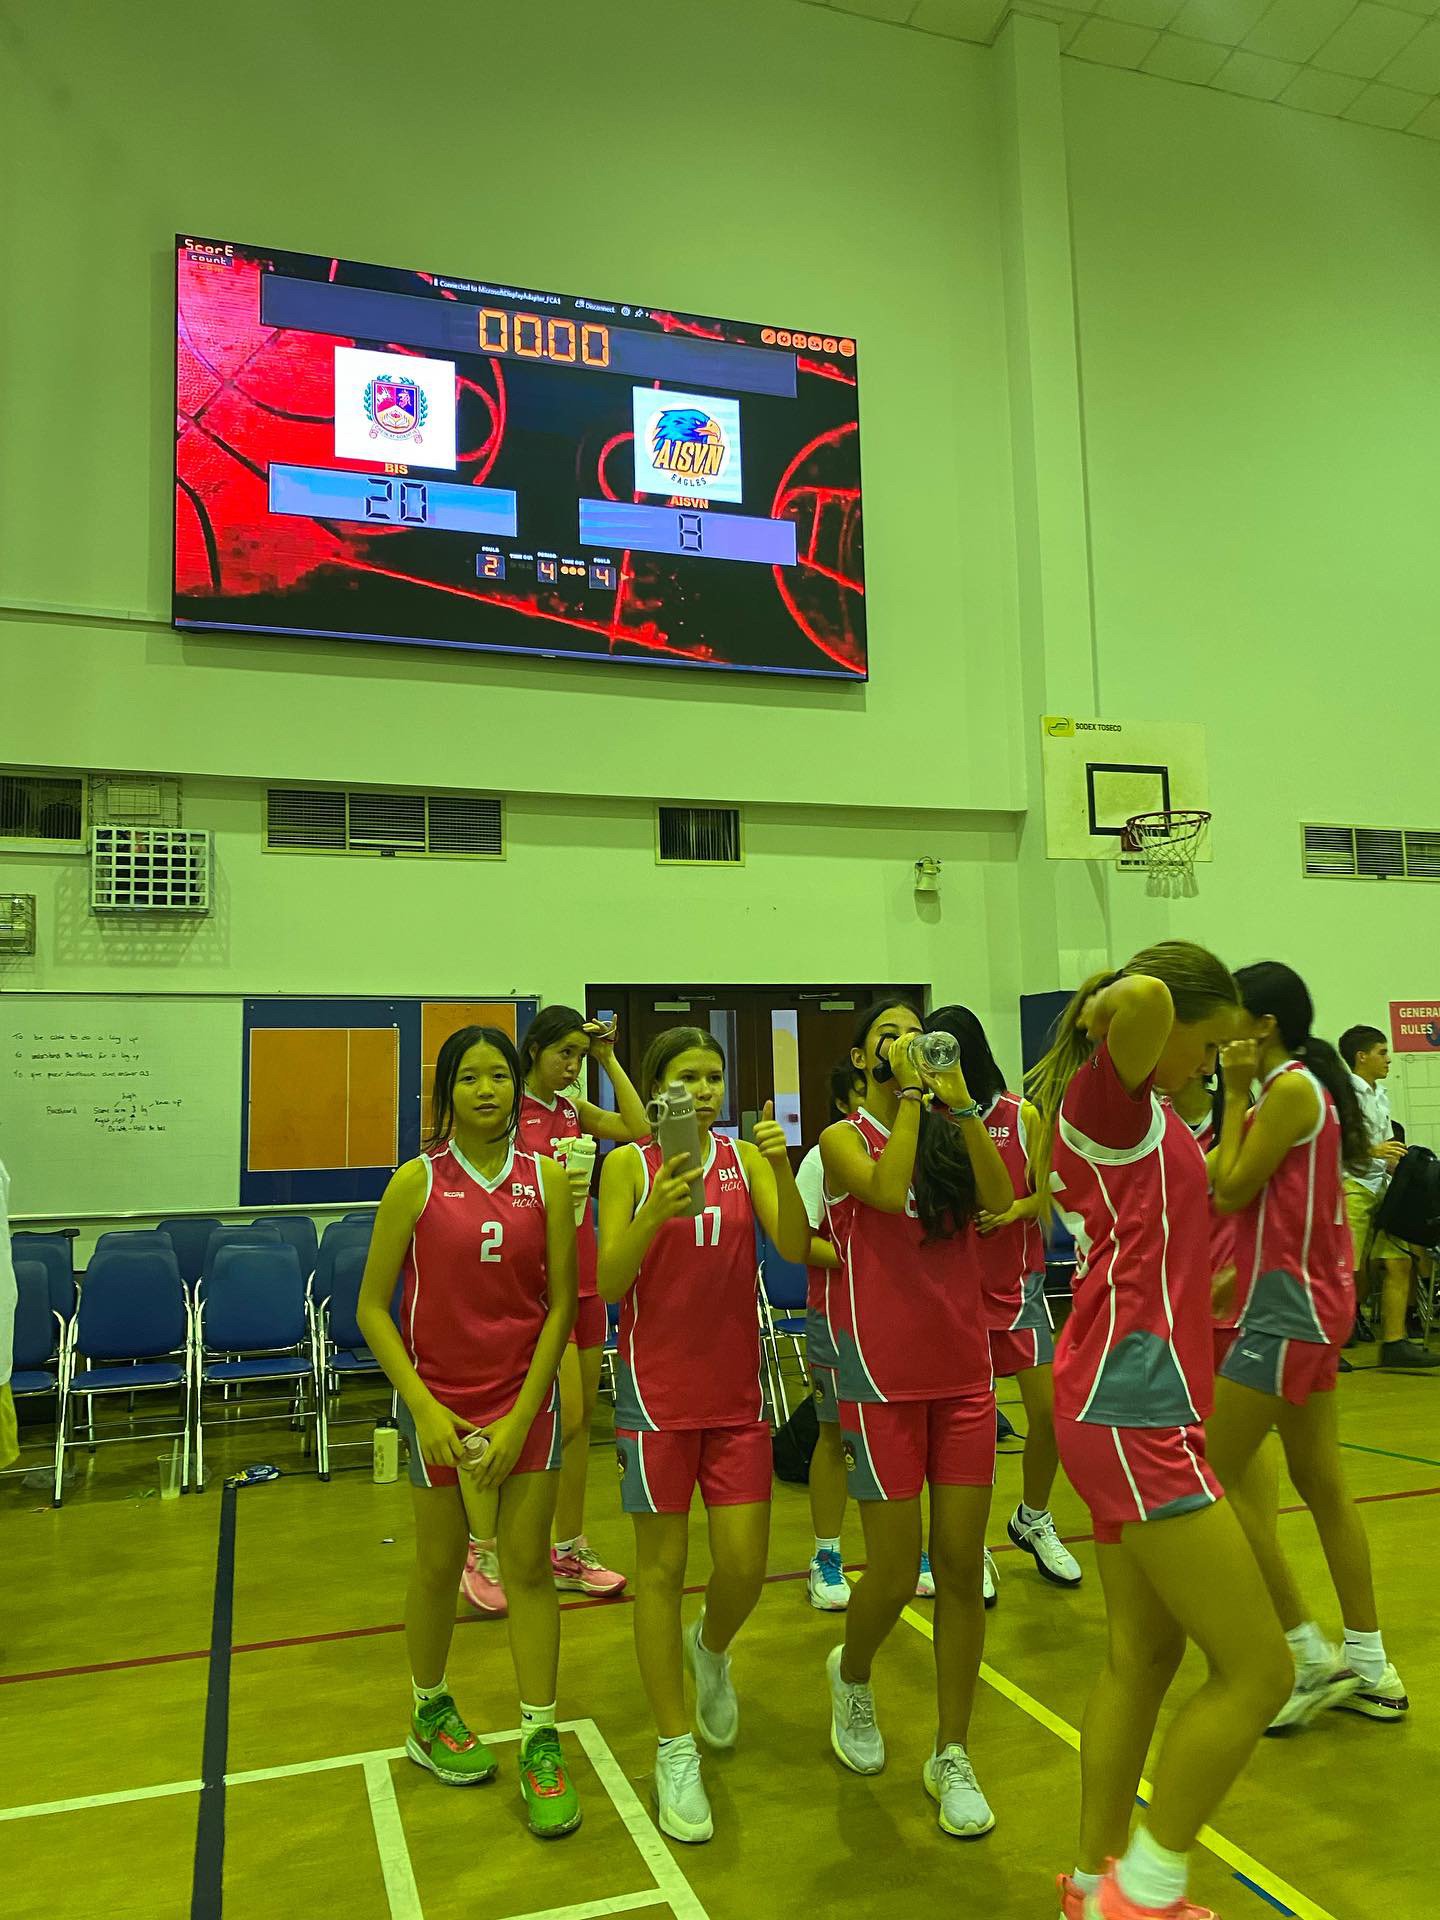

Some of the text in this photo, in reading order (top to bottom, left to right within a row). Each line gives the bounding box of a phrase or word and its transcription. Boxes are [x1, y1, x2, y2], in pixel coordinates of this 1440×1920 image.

[191, 254, 227, 266] count
[439, 280, 470, 291] Connected
[585, 301, 616, 314] Disconnect
[653, 439, 725, 476] AISVN
[384, 463, 409, 475] BIS
[670, 473, 707, 487] EAGLES
[365, 478, 427, 523] 20
[671, 495, 709, 509] AISVN
[678, 513, 703, 552] 8
[484, 556, 499, 577] 2
[541, 562, 555, 581] 4
[596, 568, 609, 587] 4
[1075, 722, 1121, 732] SODEX TOSECO
[1399, 1007, 1440, 1018] GENERA
[1400, 1024, 1433, 1035] RULES
[988, 1127, 1010, 1138] BIS
[718, 1166, 739, 1181] BIS
[511, 1183, 536, 1197] BIS
[694, 1206, 721, 1247] 17
[480, 1221, 504, 1263] 2
